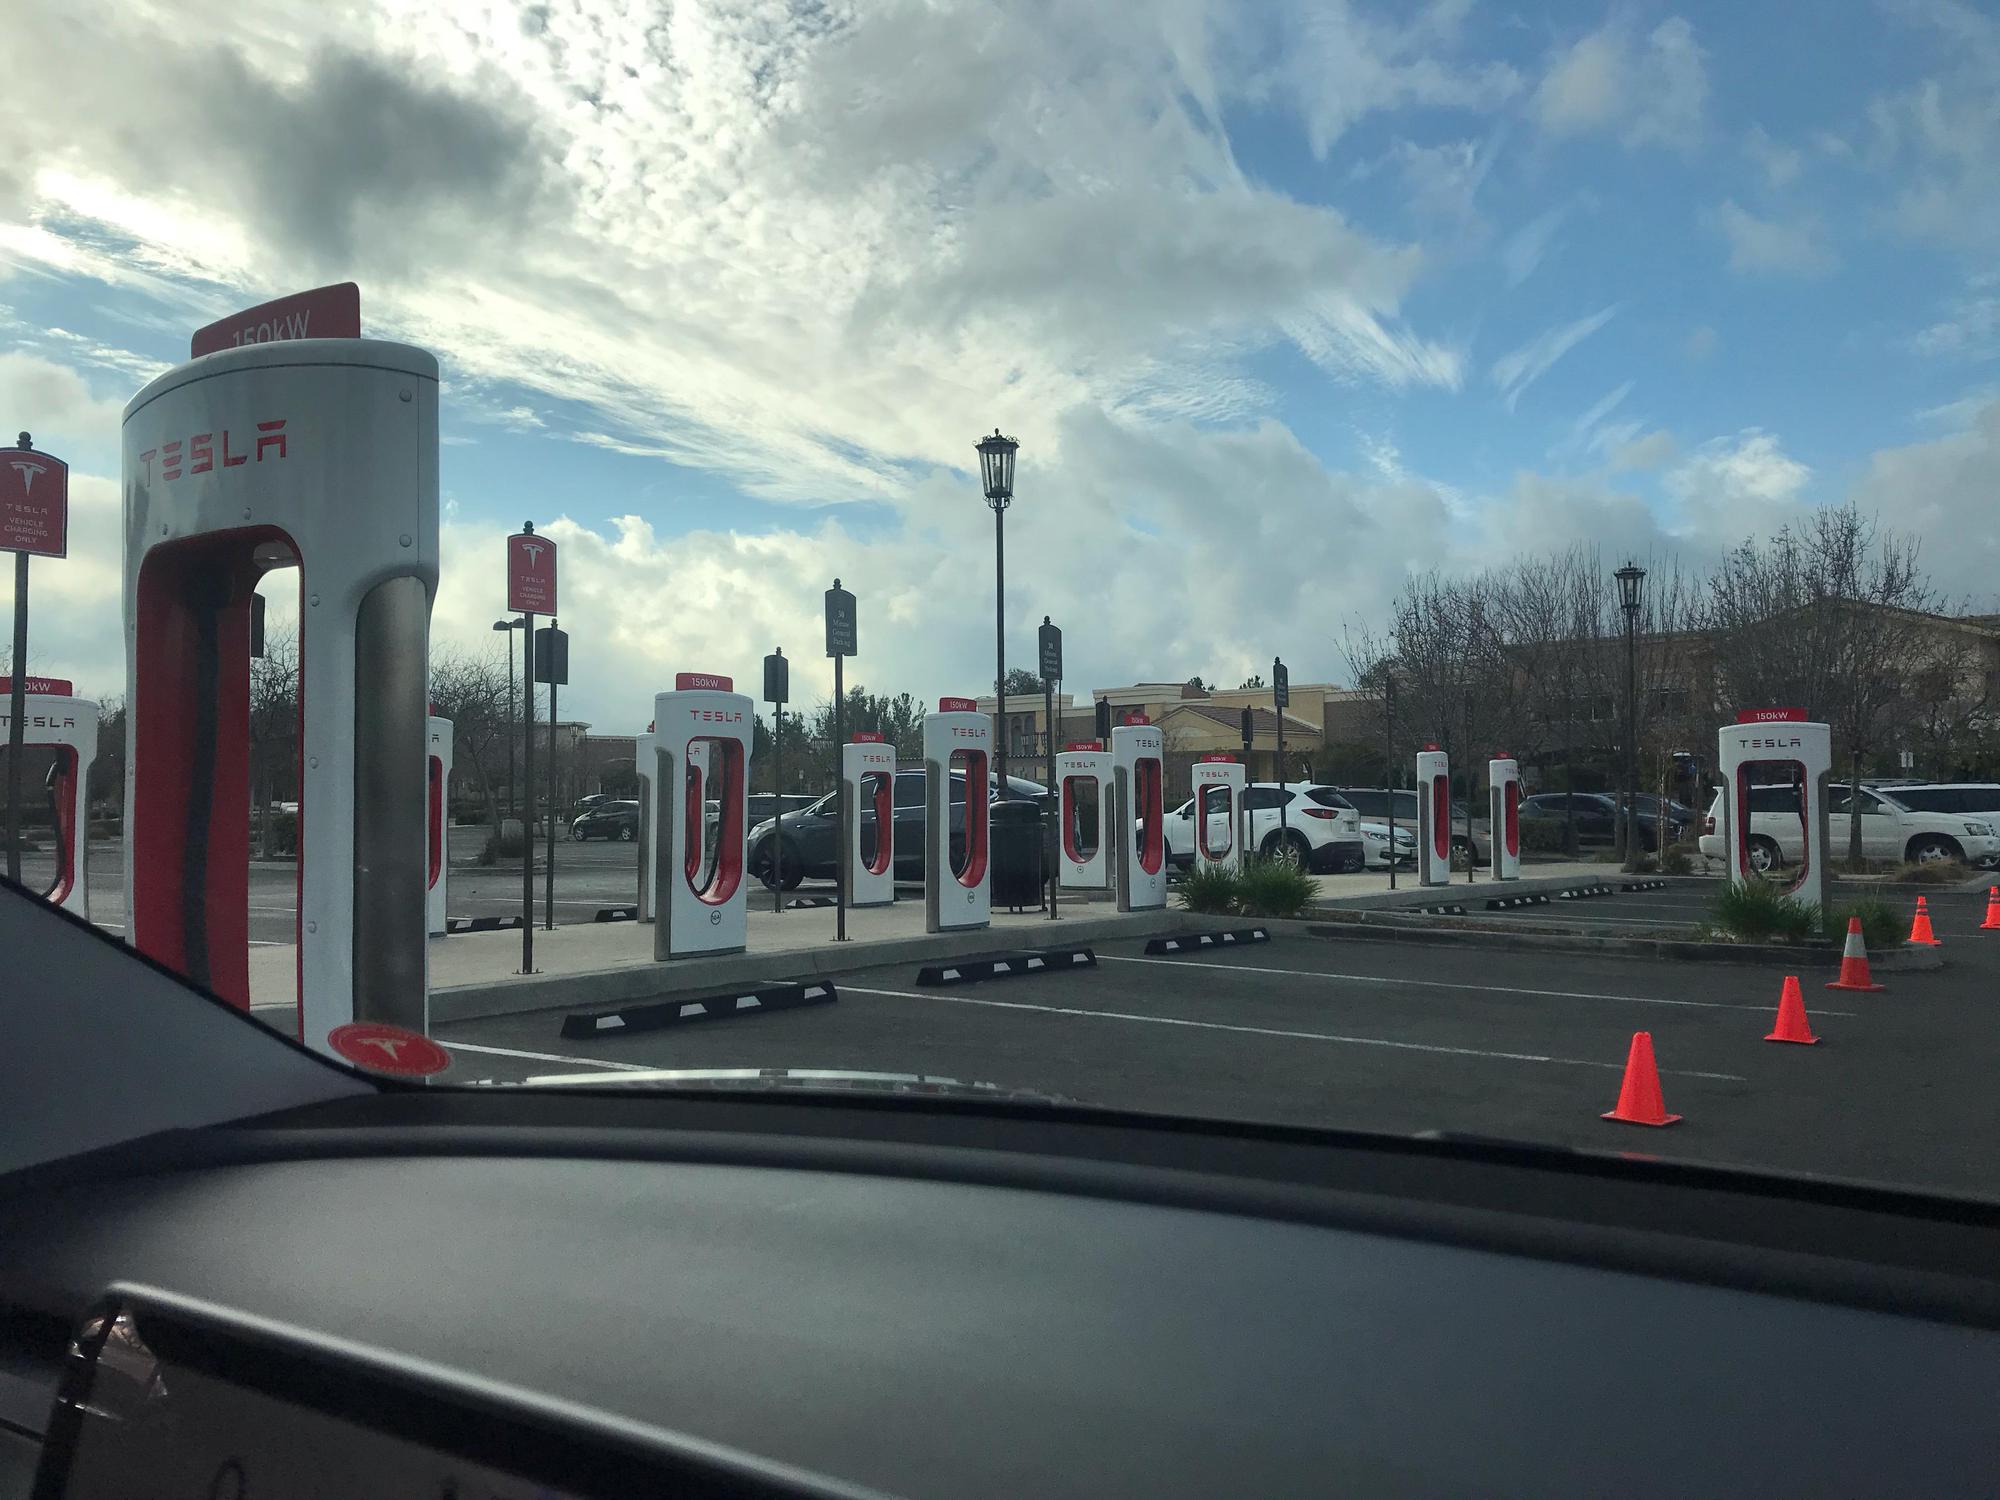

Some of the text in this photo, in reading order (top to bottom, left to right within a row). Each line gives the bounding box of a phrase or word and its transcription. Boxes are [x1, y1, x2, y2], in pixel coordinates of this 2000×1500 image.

[233, 309, 310, 347] 150kW
[139, 419, 287, 488] TESLA
[6, 503, 48, 516] TESLA
[10, 516, 44, 528] VEHICLE
[4, 524, 49, 537] CHARGING
[15, 535, 37, 544] ONLY
[691, 677, 719, 688] 150kW
[949, 701, 968, 709] 150kW
[690, 710, 742, 722] TESLA
[1755, 711, 1789, 721] 150kW
[861, 734, 877, 742] 150kW
[951, 727, 987, 738] TESLA
[1136, 739, 1160, 748] TESLA
[1739, 738, 1801, 748] TESLA
[862, 755, 891, 763] TESLA
